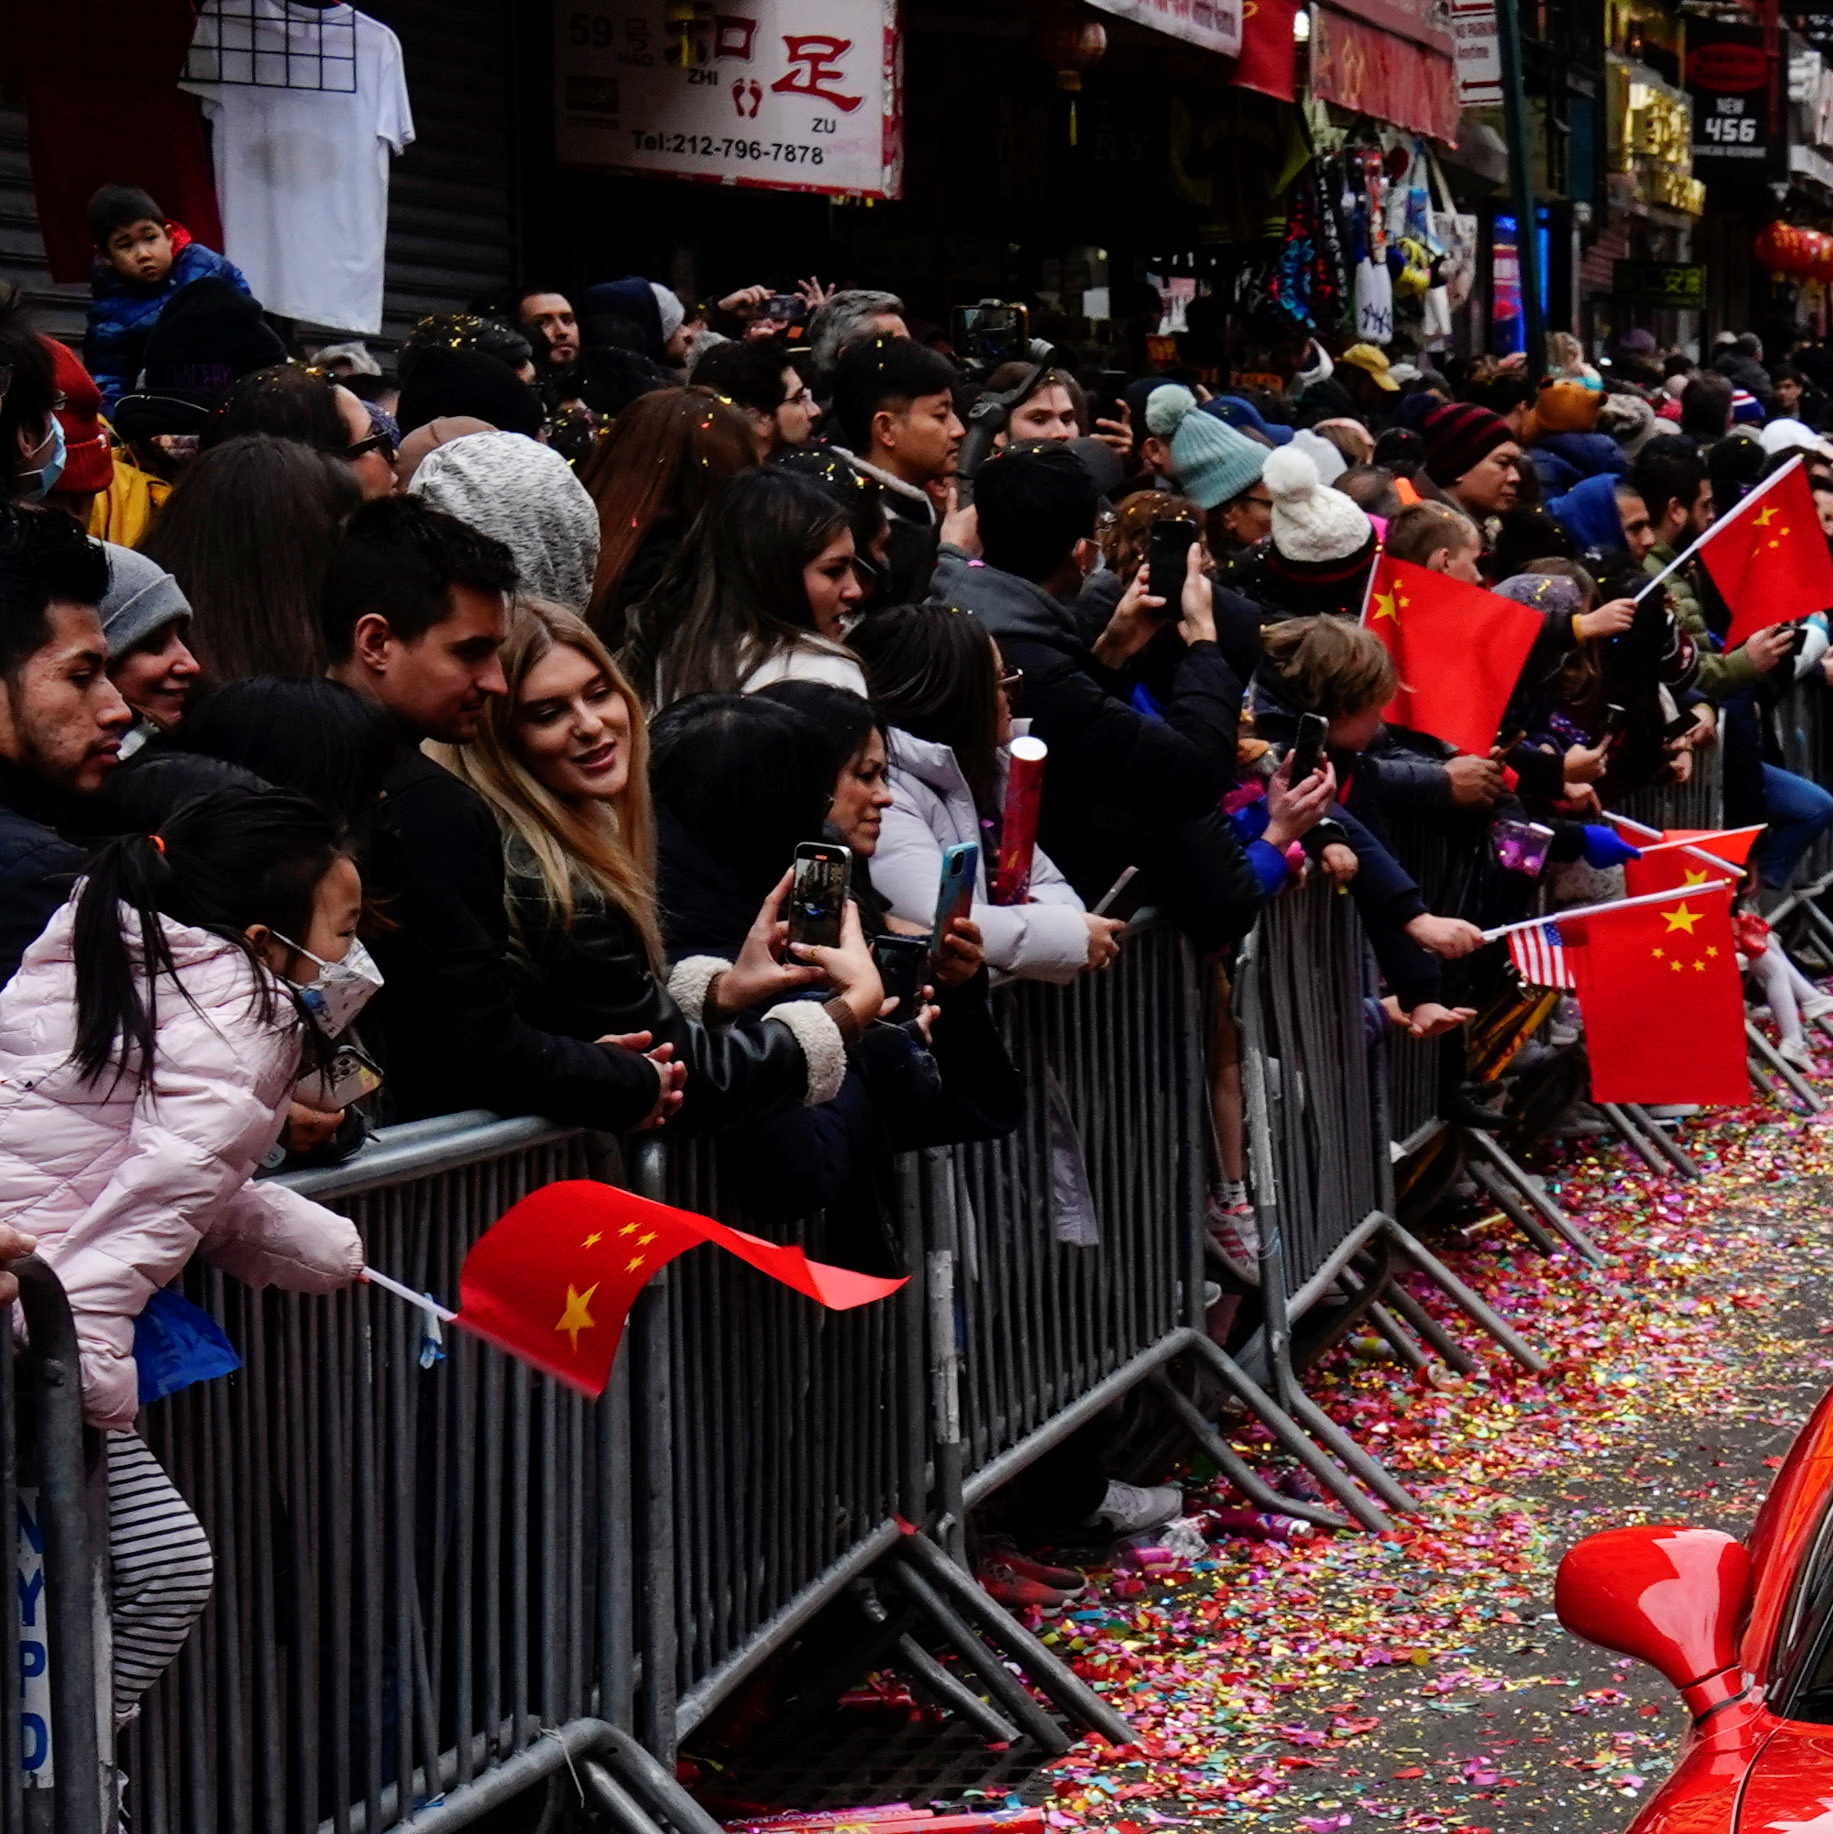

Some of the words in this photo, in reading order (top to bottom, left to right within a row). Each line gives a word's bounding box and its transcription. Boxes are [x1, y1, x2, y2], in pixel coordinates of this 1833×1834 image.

[811, 117, 837, 133] ZU
[1704, 117, 1757, 142] 456
[630, 129, 825, 165] Tel:212-796-7878
